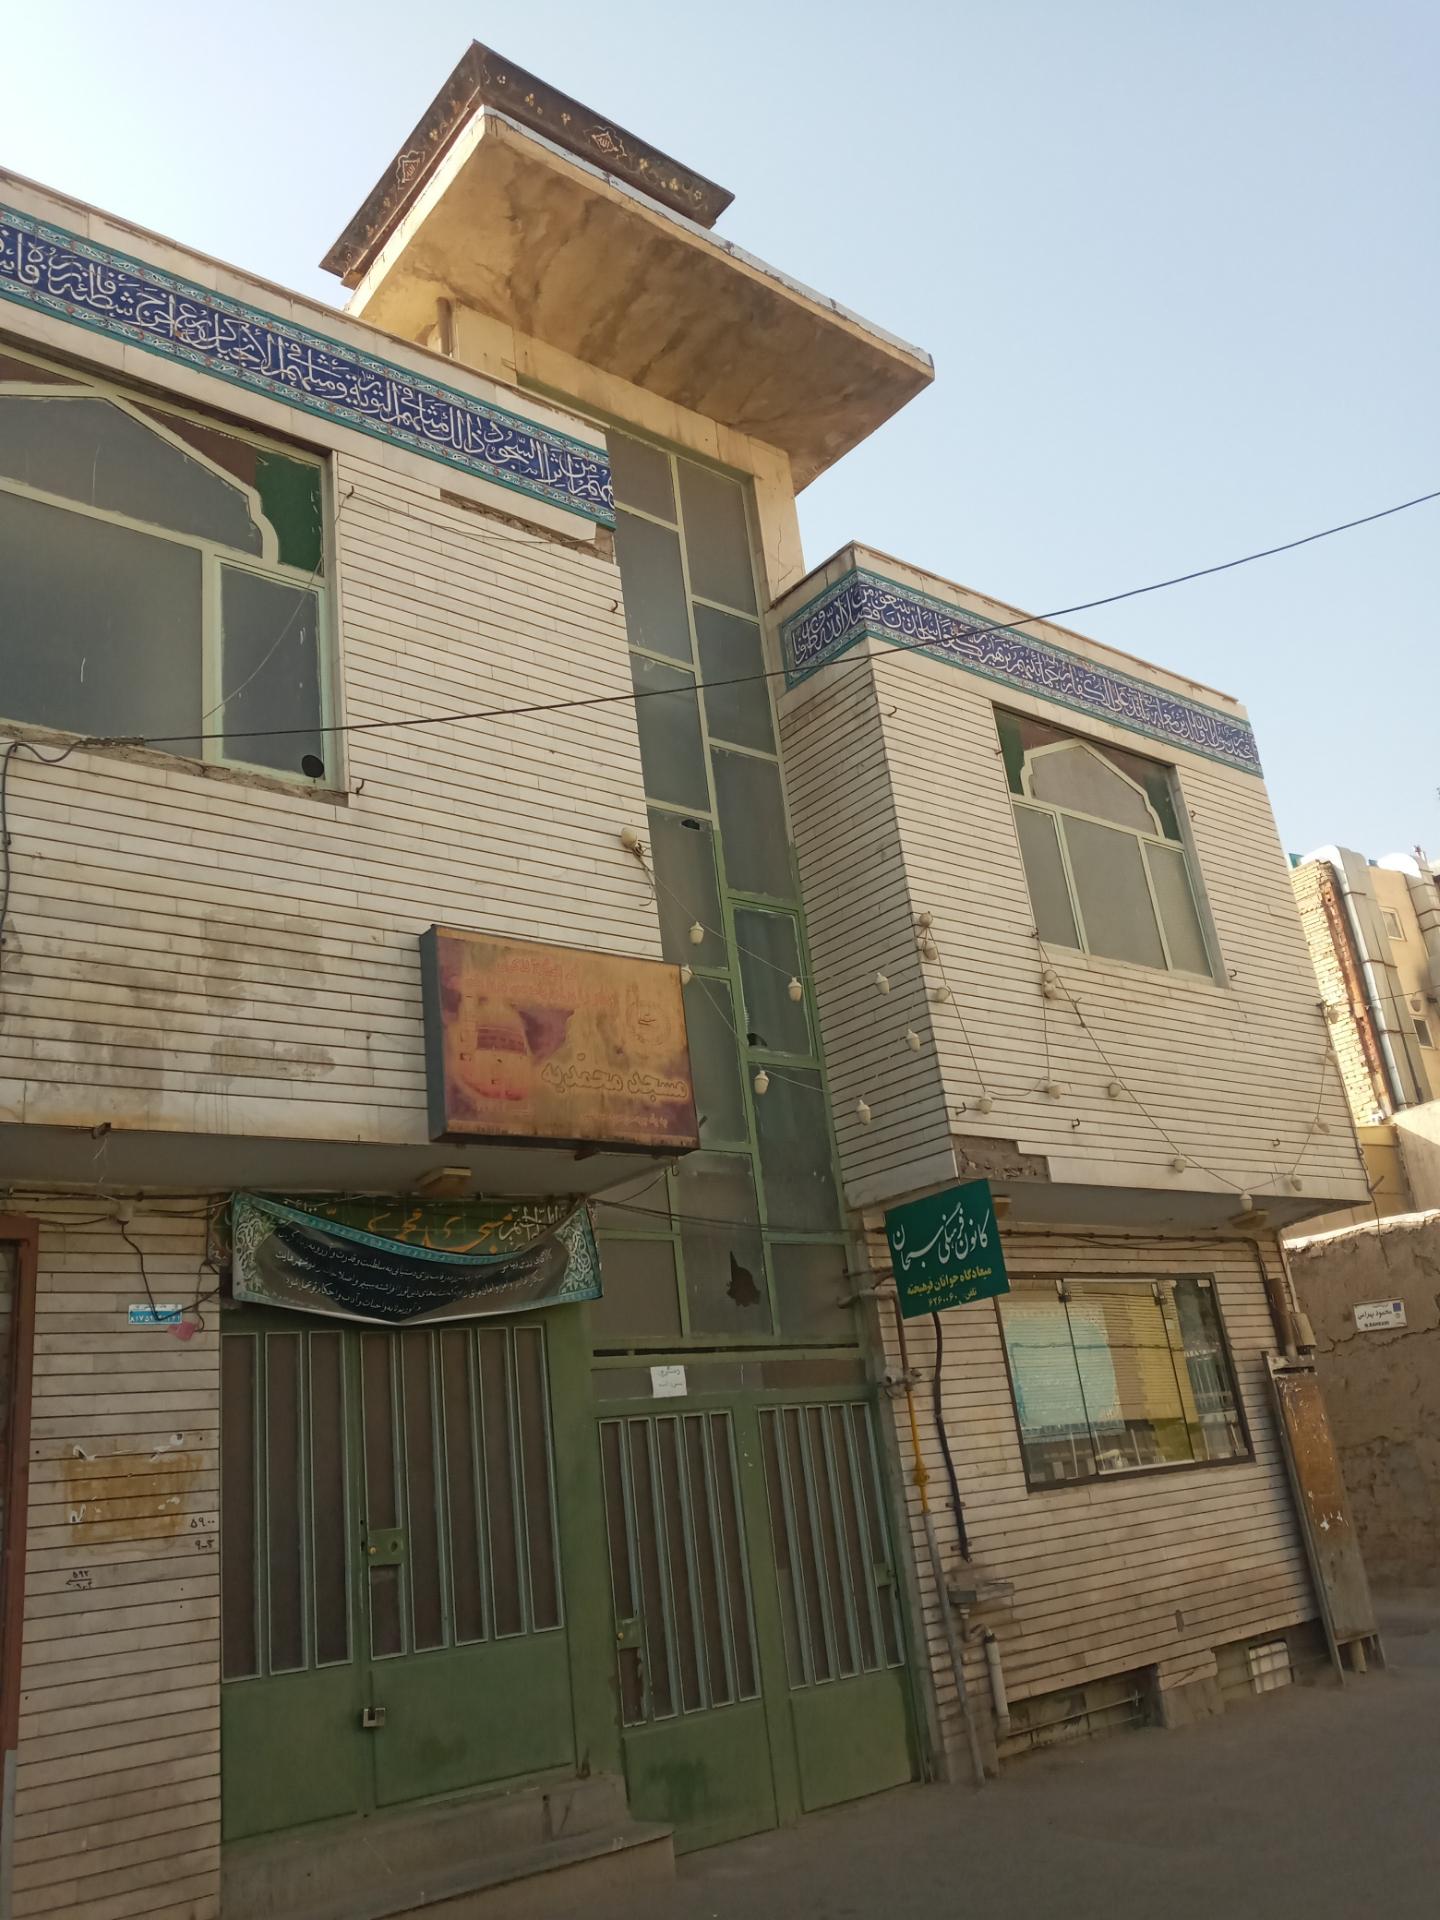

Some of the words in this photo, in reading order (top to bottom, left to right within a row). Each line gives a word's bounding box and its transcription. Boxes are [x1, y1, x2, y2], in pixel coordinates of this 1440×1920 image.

[892, 1223, 945, 1271] سبحان
[954, 1207, 990, 1261] کانون
[933, 1273, 960, 1291] جوانان
